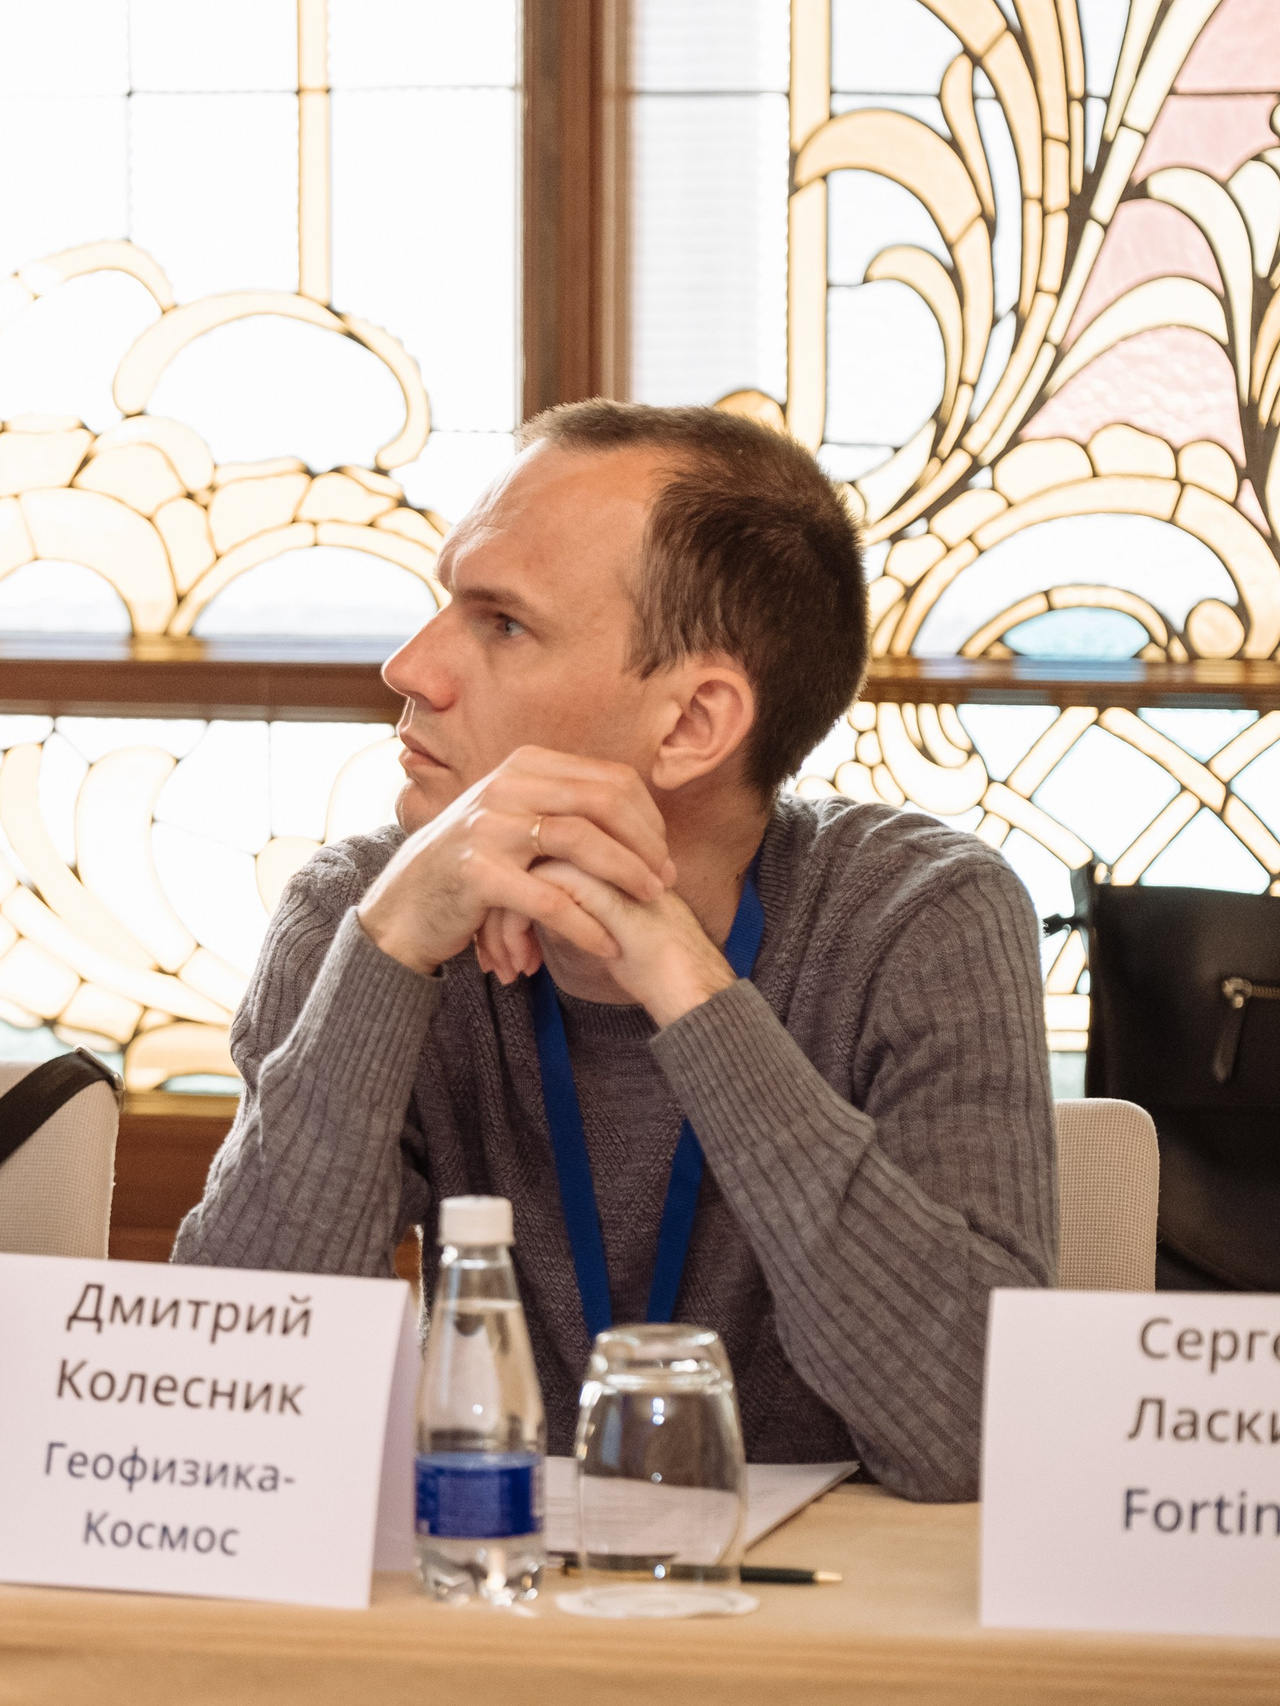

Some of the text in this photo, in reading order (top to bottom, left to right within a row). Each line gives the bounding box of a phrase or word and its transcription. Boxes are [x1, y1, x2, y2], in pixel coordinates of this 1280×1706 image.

[65, 1282, 313, 1345] Дмитрий
[1139, 1316, 1280, 1376] Серг
[56, 1358, 305, 1416] Колесник
[44, 1441, 295, 1493] Геофизика-
[82, 1510, 239, 1557] Космос
